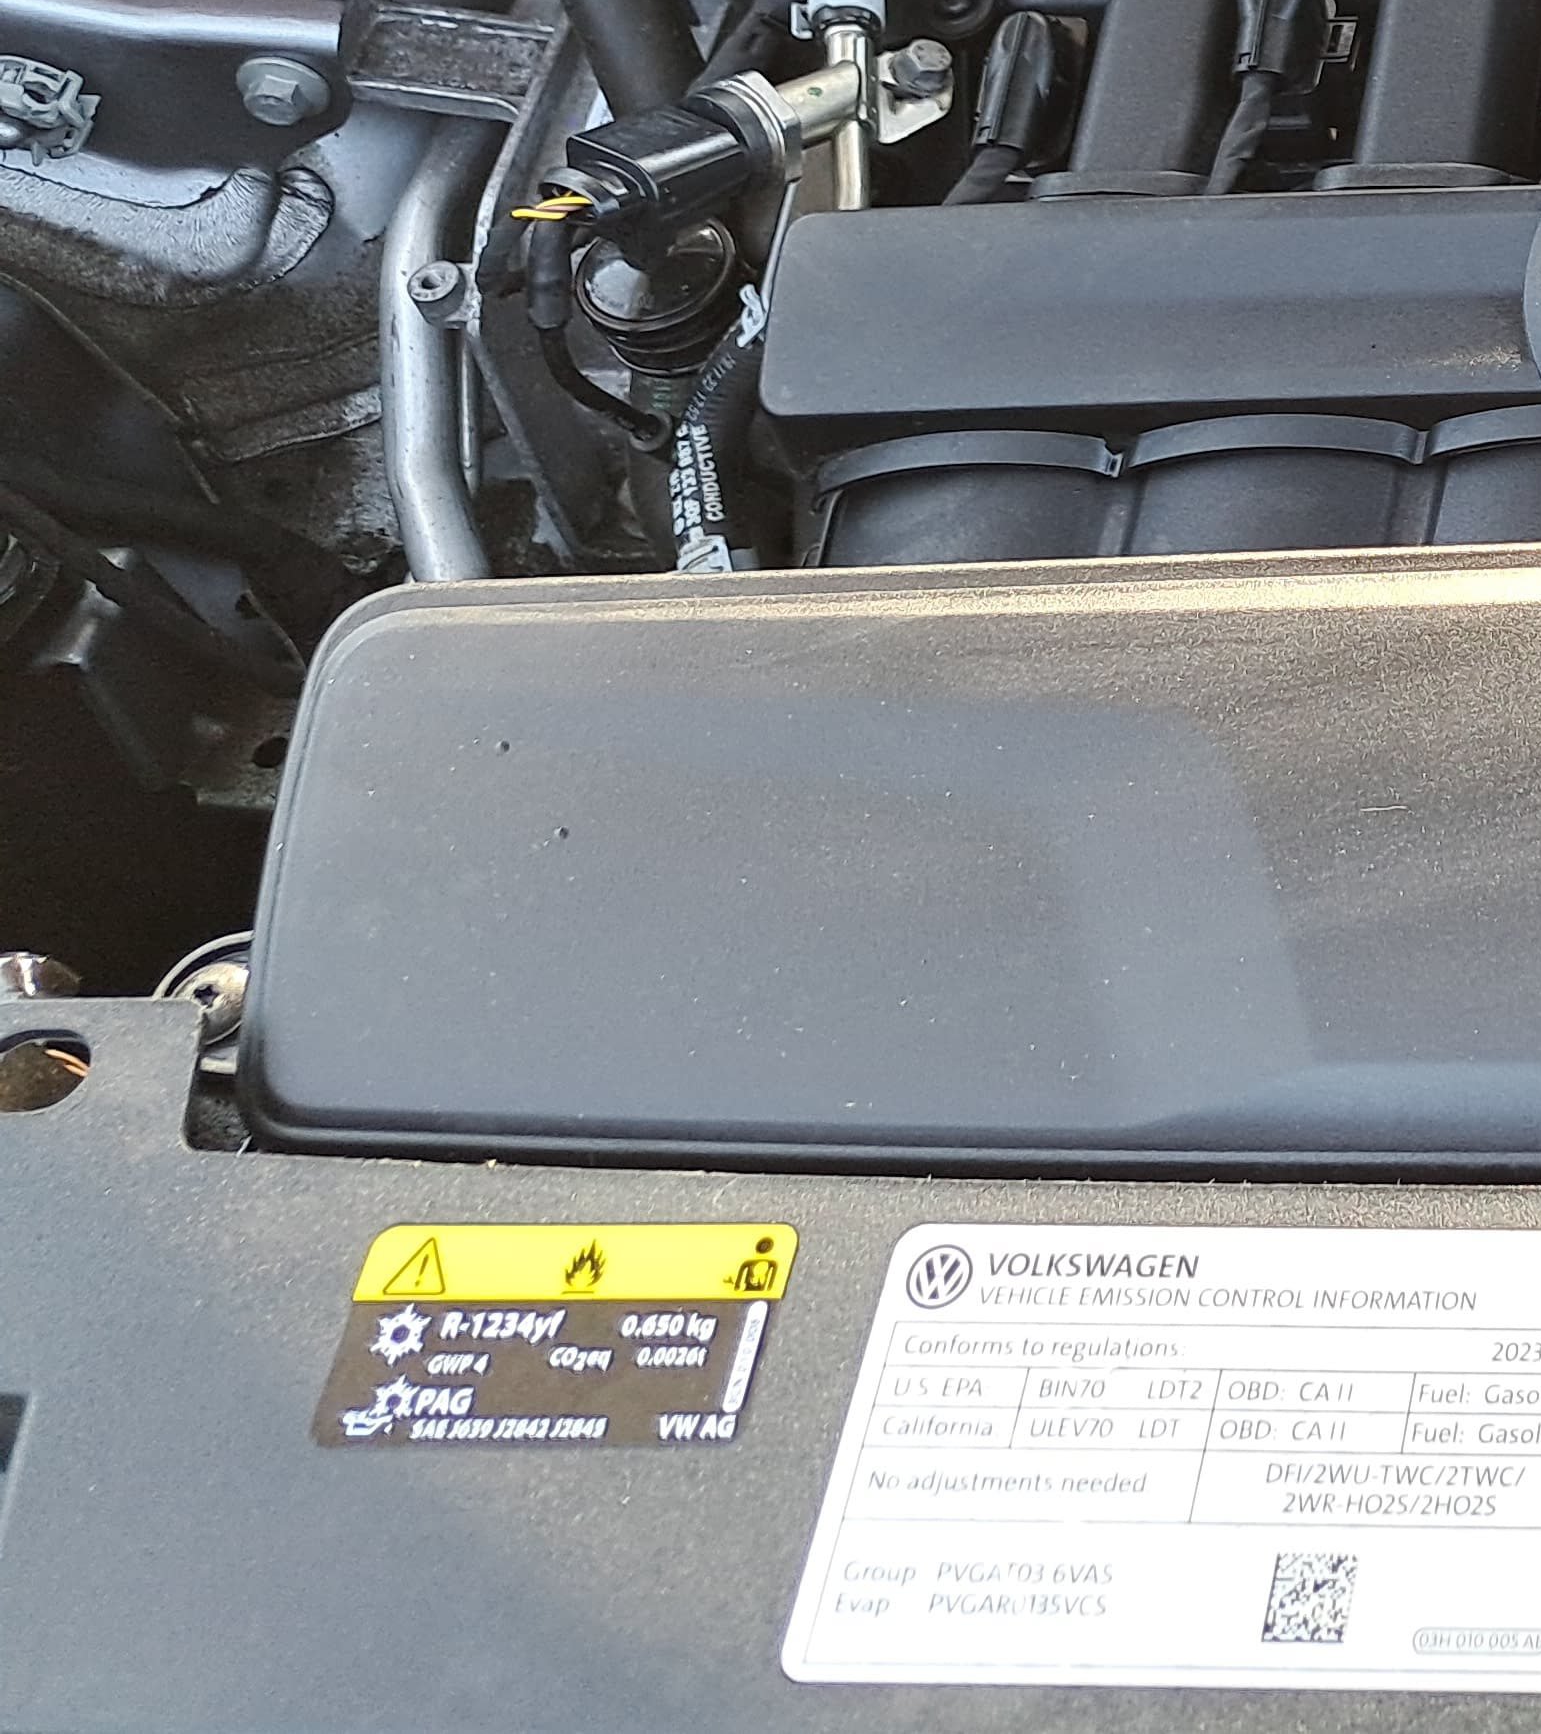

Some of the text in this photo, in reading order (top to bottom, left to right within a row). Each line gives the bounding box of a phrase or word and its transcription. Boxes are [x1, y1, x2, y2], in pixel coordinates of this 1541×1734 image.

[692, 423, 725, 522] CONDUCTIVE
[989, 1253, 1199, 1279] VOLKSWAGEN
[981, 1286, 1476, 1311] VEHICLE EMISSION CONTROL INFORMATION
[621, 1315, 686, 1338] 0.650
[687, 1313, 718, 1342] kg
[905, 1334, 1013, 1355] Conforms
[1022, 1338, 1044, 1356] to
[427, 1353, 474, 1375] GWP
[942, 1378, 982, 1397] EPA
[1039, 1378, 1202, 1402] BIN70 LDT2
[1228, 1380, 1285, 1401] OBD:
[1419, 1382, 1470, 1404] Fuel:
[414, 1387, 474, 1416] PAG
[659, 1415, 701, 1440] VW
[699, 1415, 737, 1440] AG
[1030, 1417, 1114, 1438] ULEV70
[1220, 1419, 1277, 1440] OBD:
[1412, 1421, 1464, 1444] Fuel:
[868, 1470, 1148, 1497] No adjustments needed
